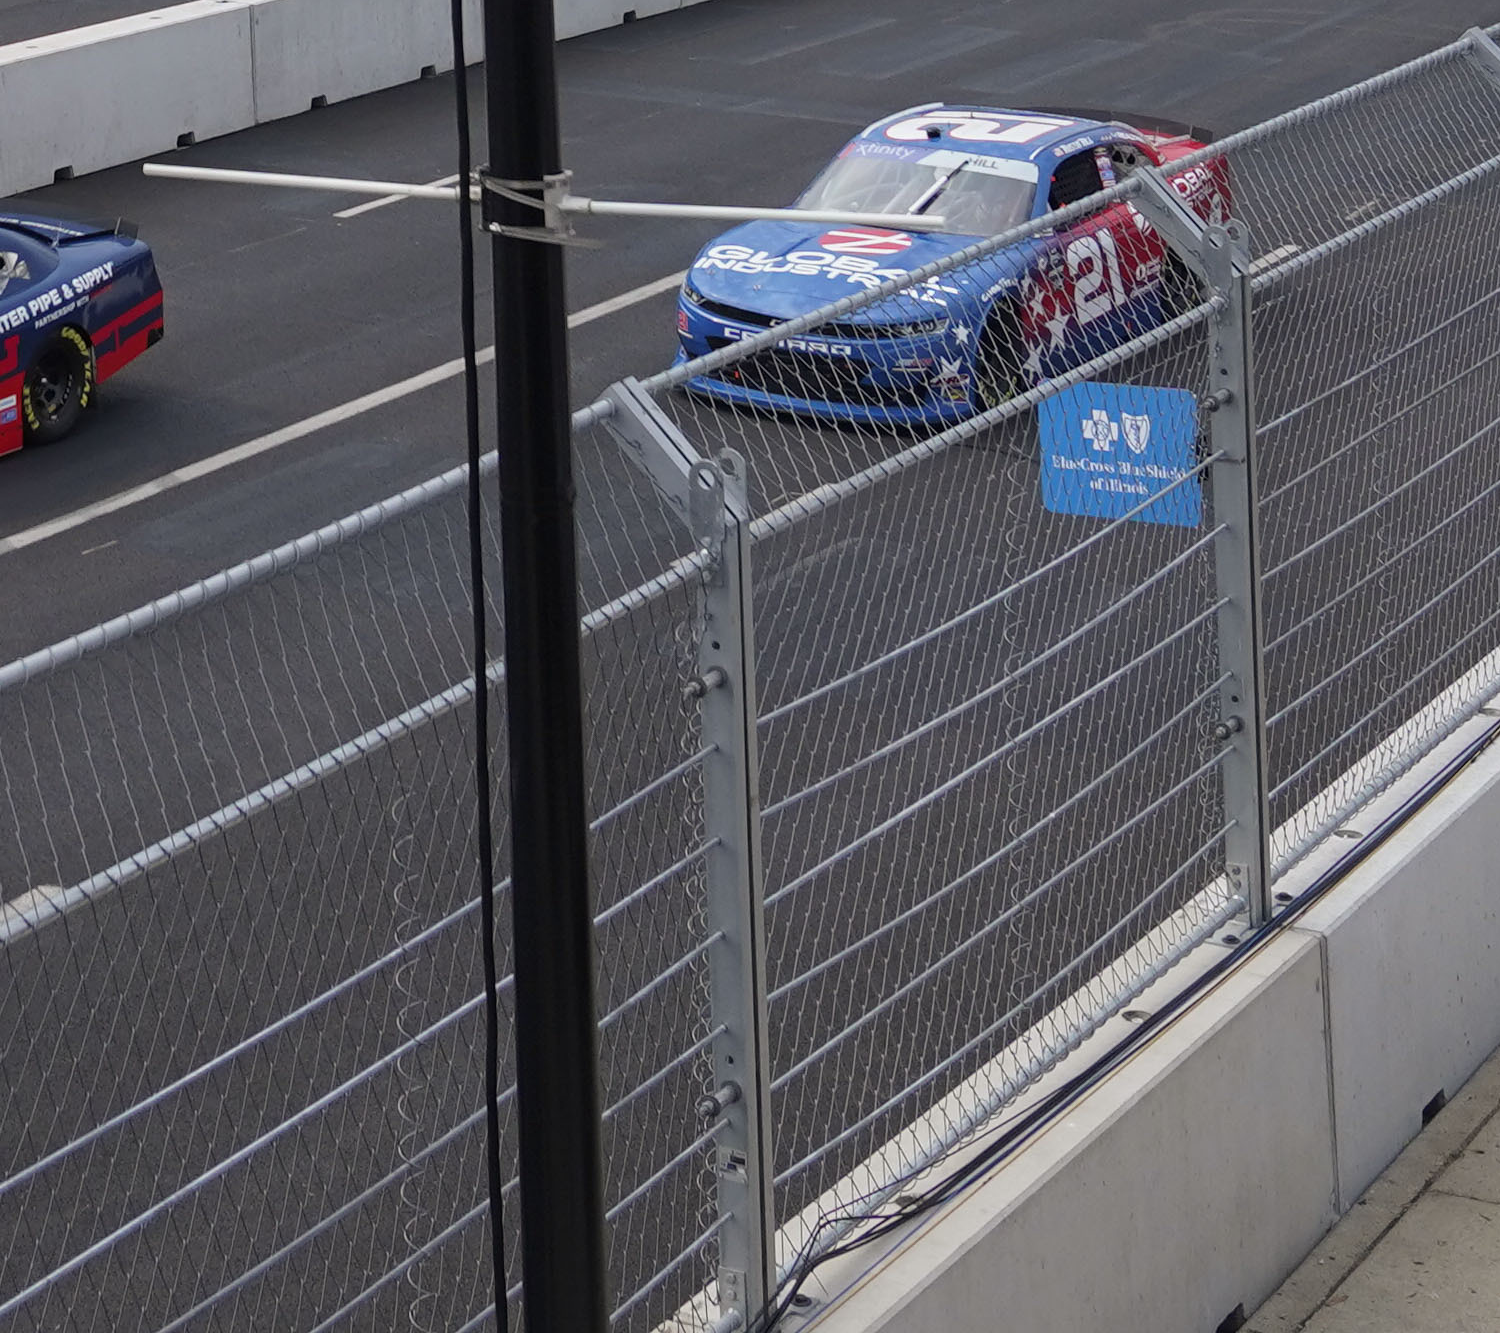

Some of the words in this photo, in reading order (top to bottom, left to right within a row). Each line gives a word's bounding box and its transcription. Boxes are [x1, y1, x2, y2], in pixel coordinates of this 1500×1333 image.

[855, 142, 916, 159] xfinity
[28, 289, 62, 317] PIPE
[62, 283, 74, 300] &
[72, 261, 114, 294] SUPPLY
[693, 256, 949, 307] INDUSTRL
[706, 244, 968, 295] GLOBL
[1066, 226, 1127, 326] 21
[723, 326, 852, 356] CAARO
[1051, 454, 1115, 474] BlueCross
[1117, 460, 1186, 482] BlueShield
[1089, 477, 1104, 491] of
[1104, 478, 1150, 495] Illinois
